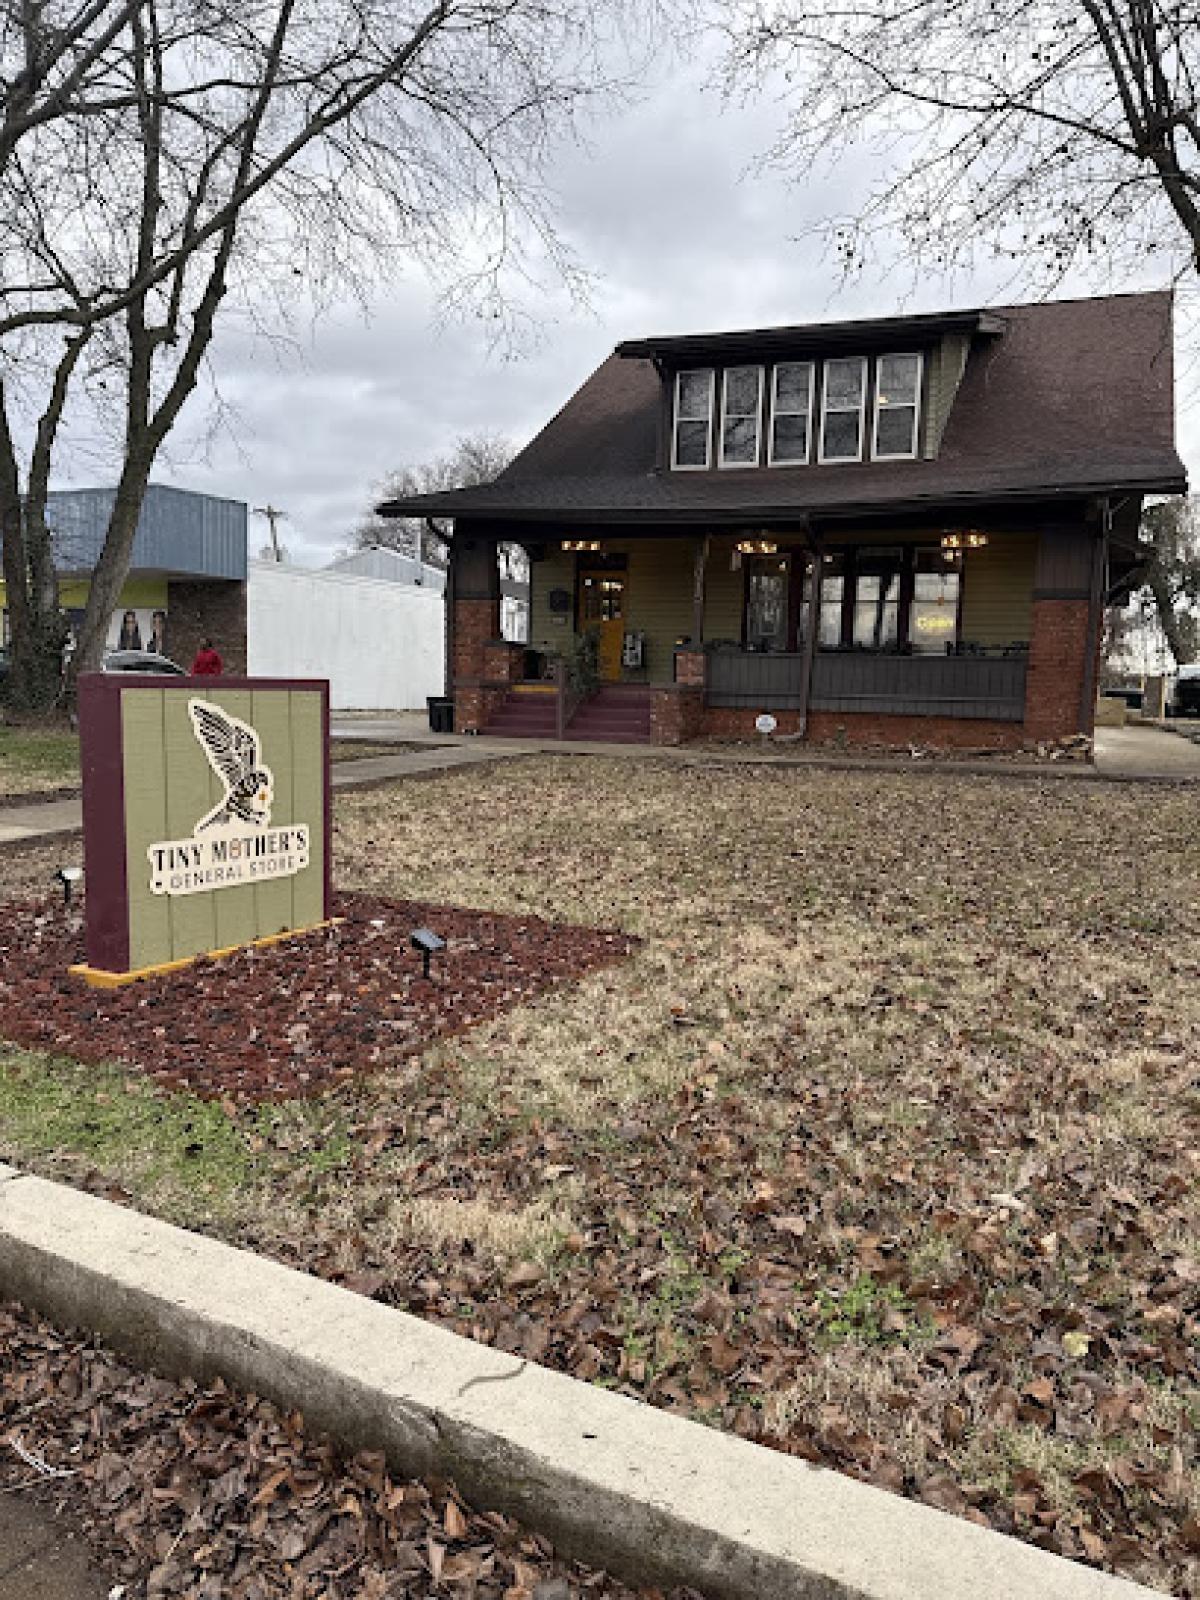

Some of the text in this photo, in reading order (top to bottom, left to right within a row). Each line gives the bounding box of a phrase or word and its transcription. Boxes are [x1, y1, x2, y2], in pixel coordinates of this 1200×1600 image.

[152, 829, 307, 871] TINY MOTHER'S
[169, 855, 294, 889] GENERAL STORE
